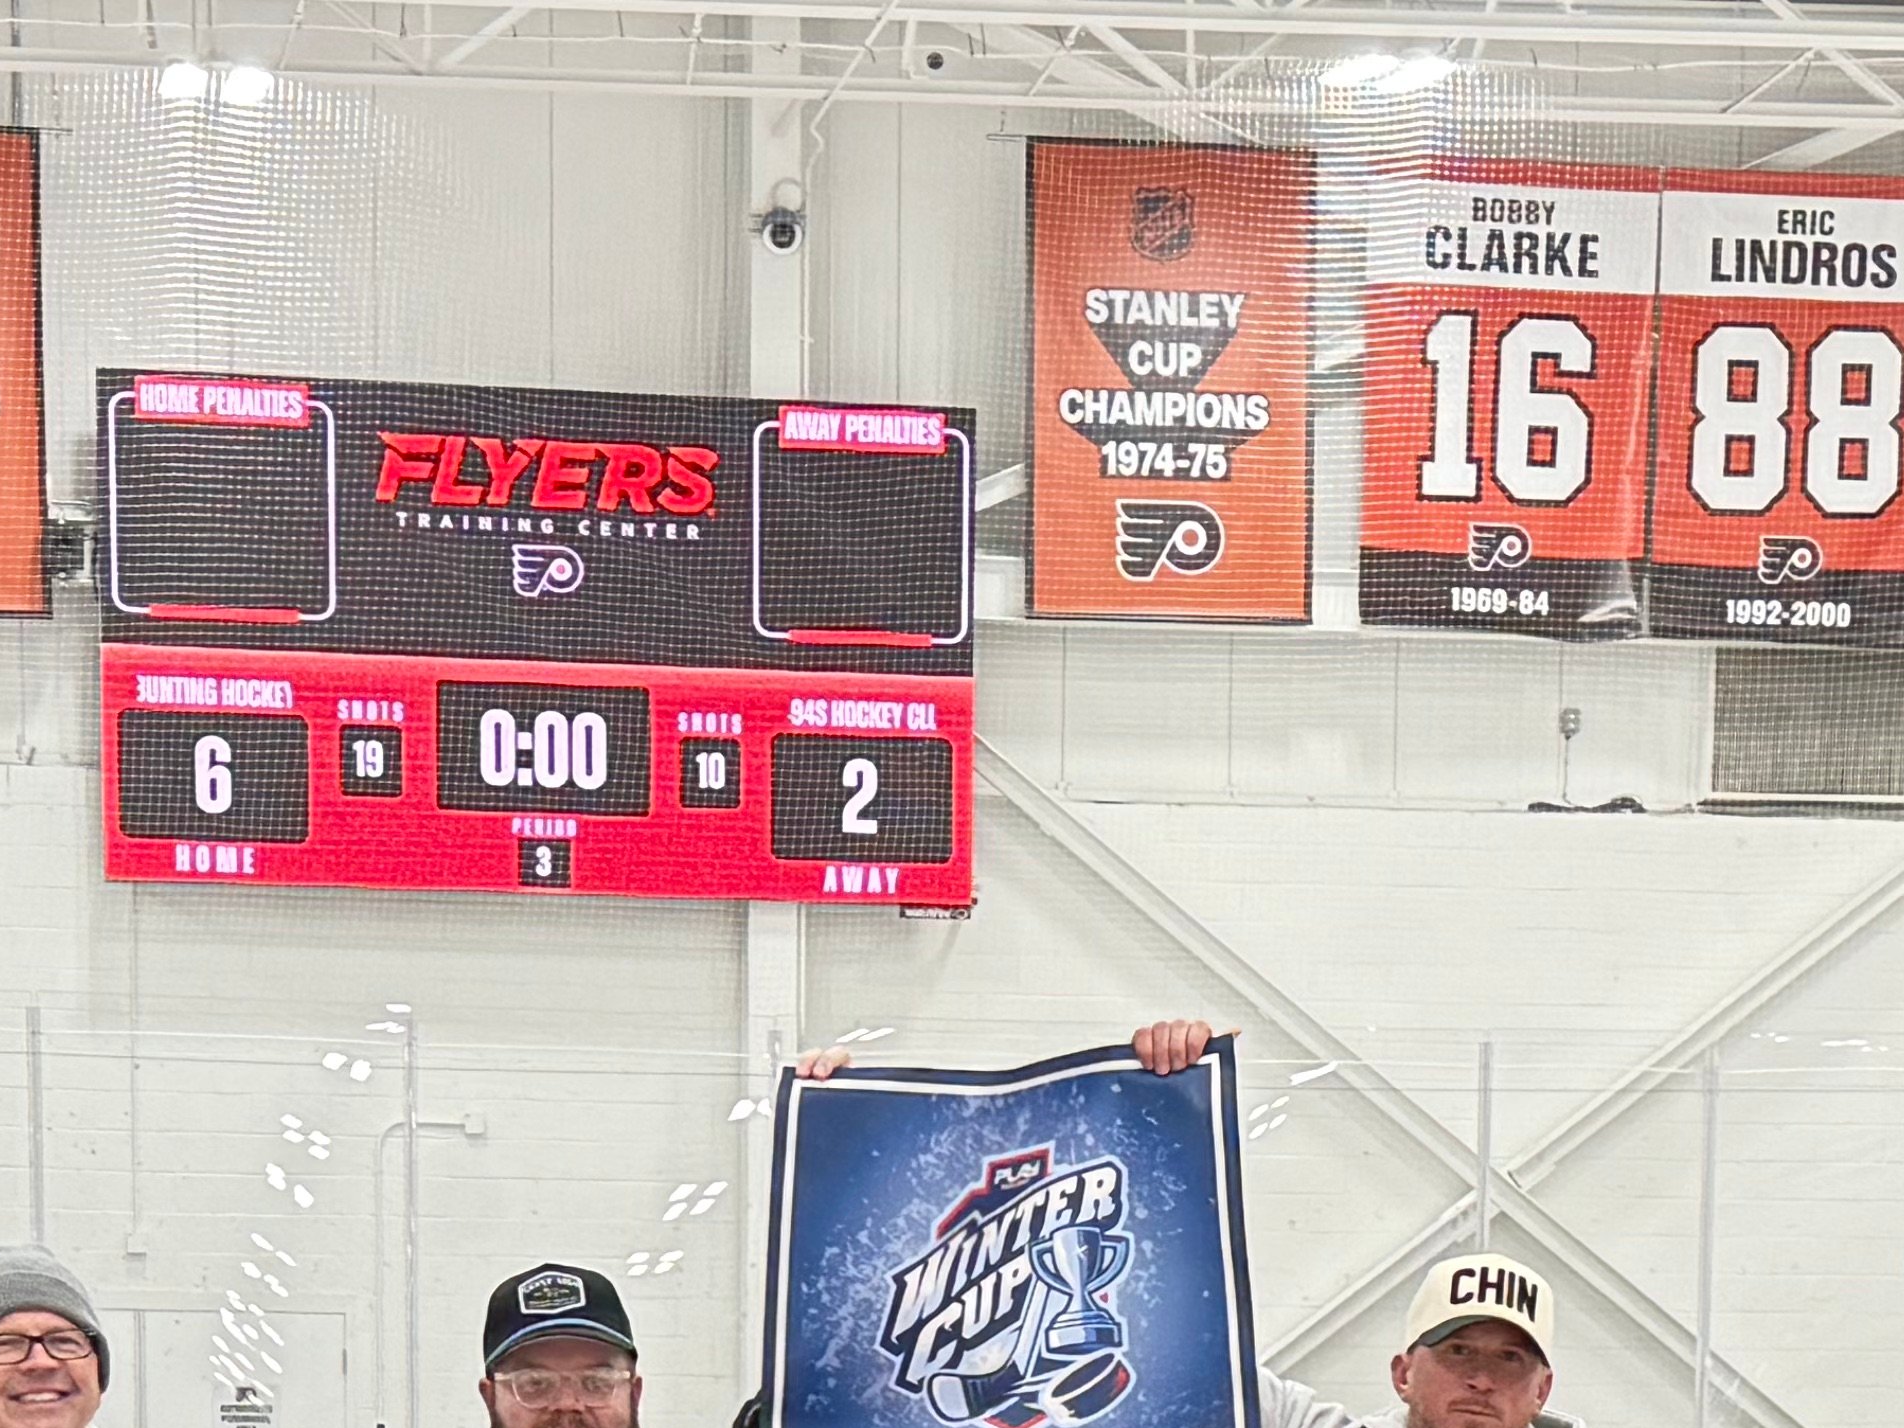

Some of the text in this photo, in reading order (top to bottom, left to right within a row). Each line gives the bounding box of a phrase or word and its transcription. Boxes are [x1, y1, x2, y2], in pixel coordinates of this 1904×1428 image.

[1472, 197, 1556, 225] BOBBY
[1777, 209, 1835, 237] ERIC
[1426, 225, 1600, 278] CLARKE
[1710, 238, 1898, 289] LINDROS
[1084, 289, 1245, 329] STANLEY
[1127, 340, 1203, 377] CUP
[139, 385, 303, 419] HOME PENALTIES
[1059, 388, 1270, 430] CHAMPIONS
[1417, 308, 1598, 508] 16
[782, 414, 942, 447] AWAY PENALTIES
[374, 431, 718, 515] FLYERS
[1101, 442, 1228, 479] 1974-75
[396, 511, 703, 541] TRAINING CENTER
[1449, 585, 1550, 616] 1969-84
[1725, 599, 1852, 628] 1992-2000
[337, 699, 405, 722] SHOTS
[677, 712, 743, 735] SHOTS
[830, 700, 904, 729] HOCKEY
[352, 739, 384, 778] 19
[480, 709, 607, 790] 0:00
[194, 734, 232, 814] 6
[696, 752, 726, 790] 10
[842, 758, 878, 834] 2
[175, 844, 255, 874] HOME
[535, 845, 552, 877] 3
[822, 865, 900, 894] AWAY
[892, 1166, 1118, 1339] WINTER
[1449, 1266, 1538, 1323] CHIN
[912, 1254, 1034, 1389] CUP
